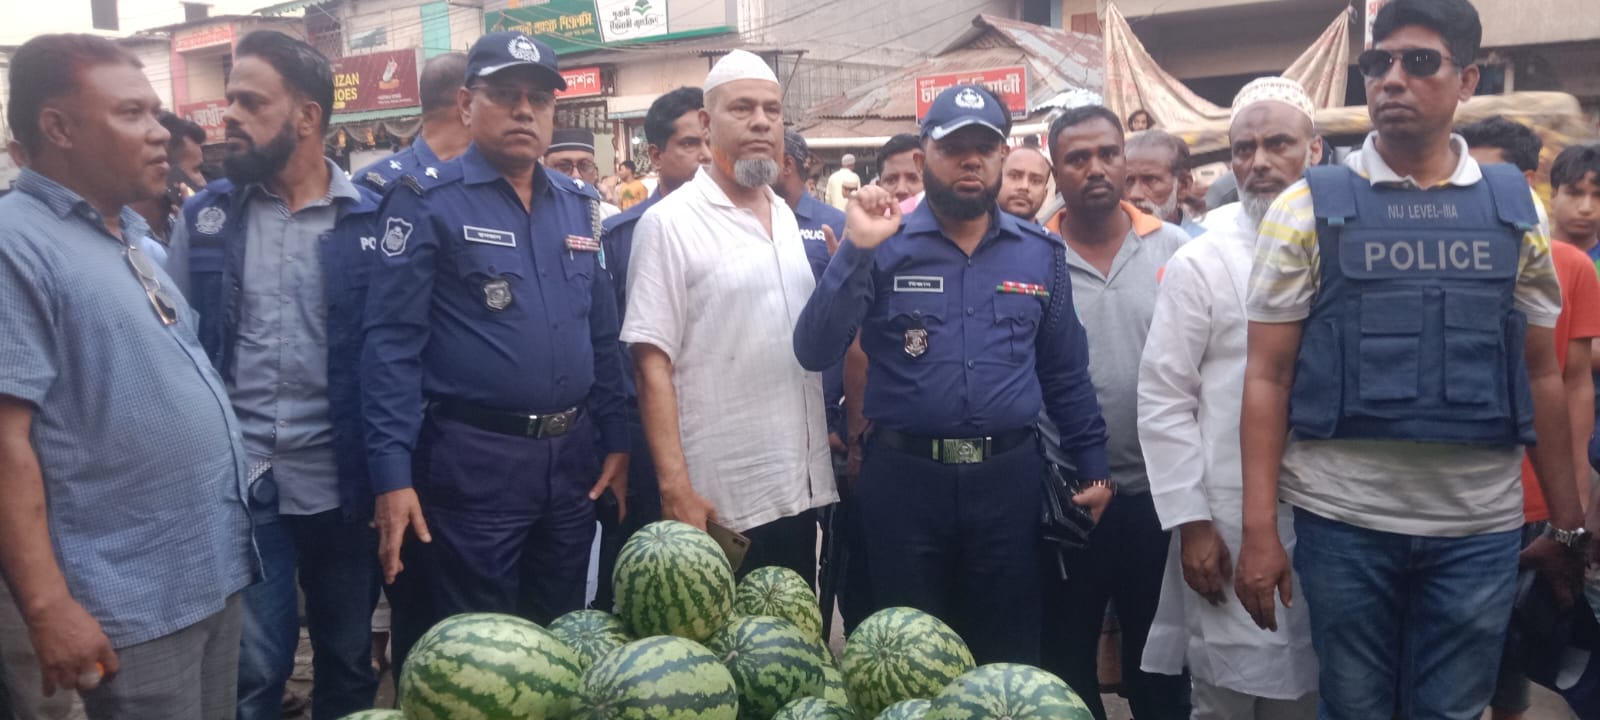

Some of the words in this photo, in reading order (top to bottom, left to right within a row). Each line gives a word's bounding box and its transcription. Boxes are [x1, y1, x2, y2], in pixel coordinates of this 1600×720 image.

[334, 72, 360, 87] IZAN
[1387, 205, 1405, 219] NIJ
[1364, 240, 1493, 272] POLICE
